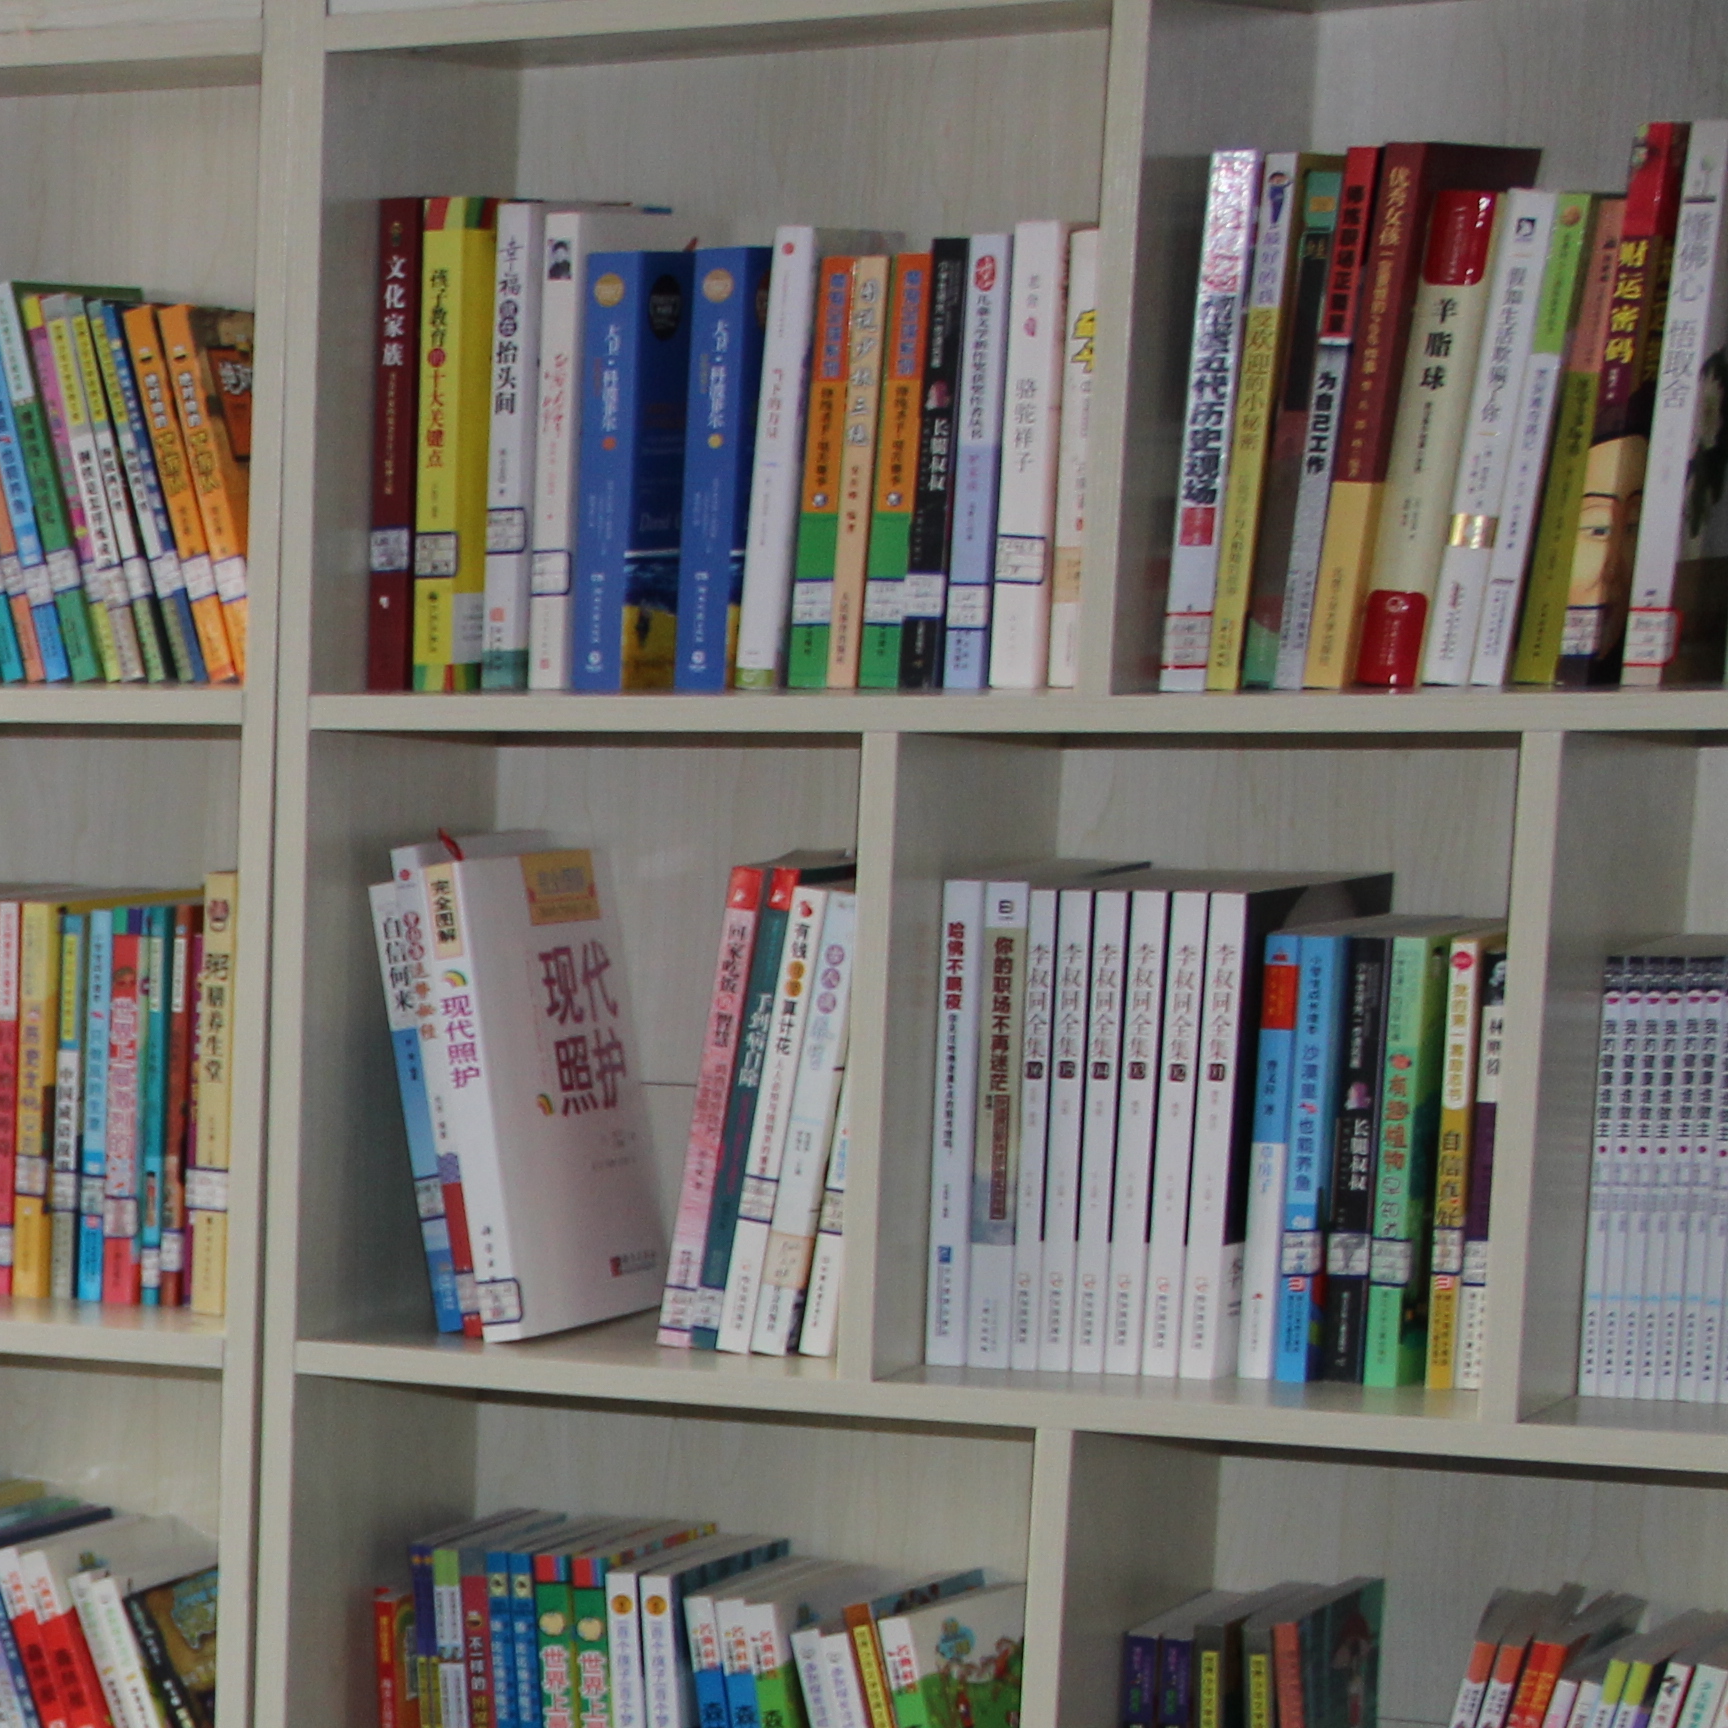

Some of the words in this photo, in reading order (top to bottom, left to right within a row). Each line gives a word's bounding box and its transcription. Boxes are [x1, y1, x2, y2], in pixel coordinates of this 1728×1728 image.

[382, 255, 406, 366] 文化家族
[1419, 297, 1457, 390] 羊脂球
[1604, 238, 1648, 364] 财运密码
[1015, 378, 1037, 473] 骆驼祥子
[1305, 371, 1338, 475] 为自己工作
[538, 938, 619, 1026] 现代
[989, 936, 1014, 1093] 你的职场不再迷茫
[1028, 944, 1050, 1059] 李叔同全集
[1060, 944, 1082, 1059] 李叔同全集
[1092, 944, 1118, 1059] 李叔同全集
[1130, 944, 1155, 1059] 李叔同全集
[1172, 945, 1196, 1060] 李叔同全集
[1209, 944, 1237, 1059] 李叔同全集
[441, 994, 481, 1089] 现代照护
[554, 1026, 626, 1117] 照护
